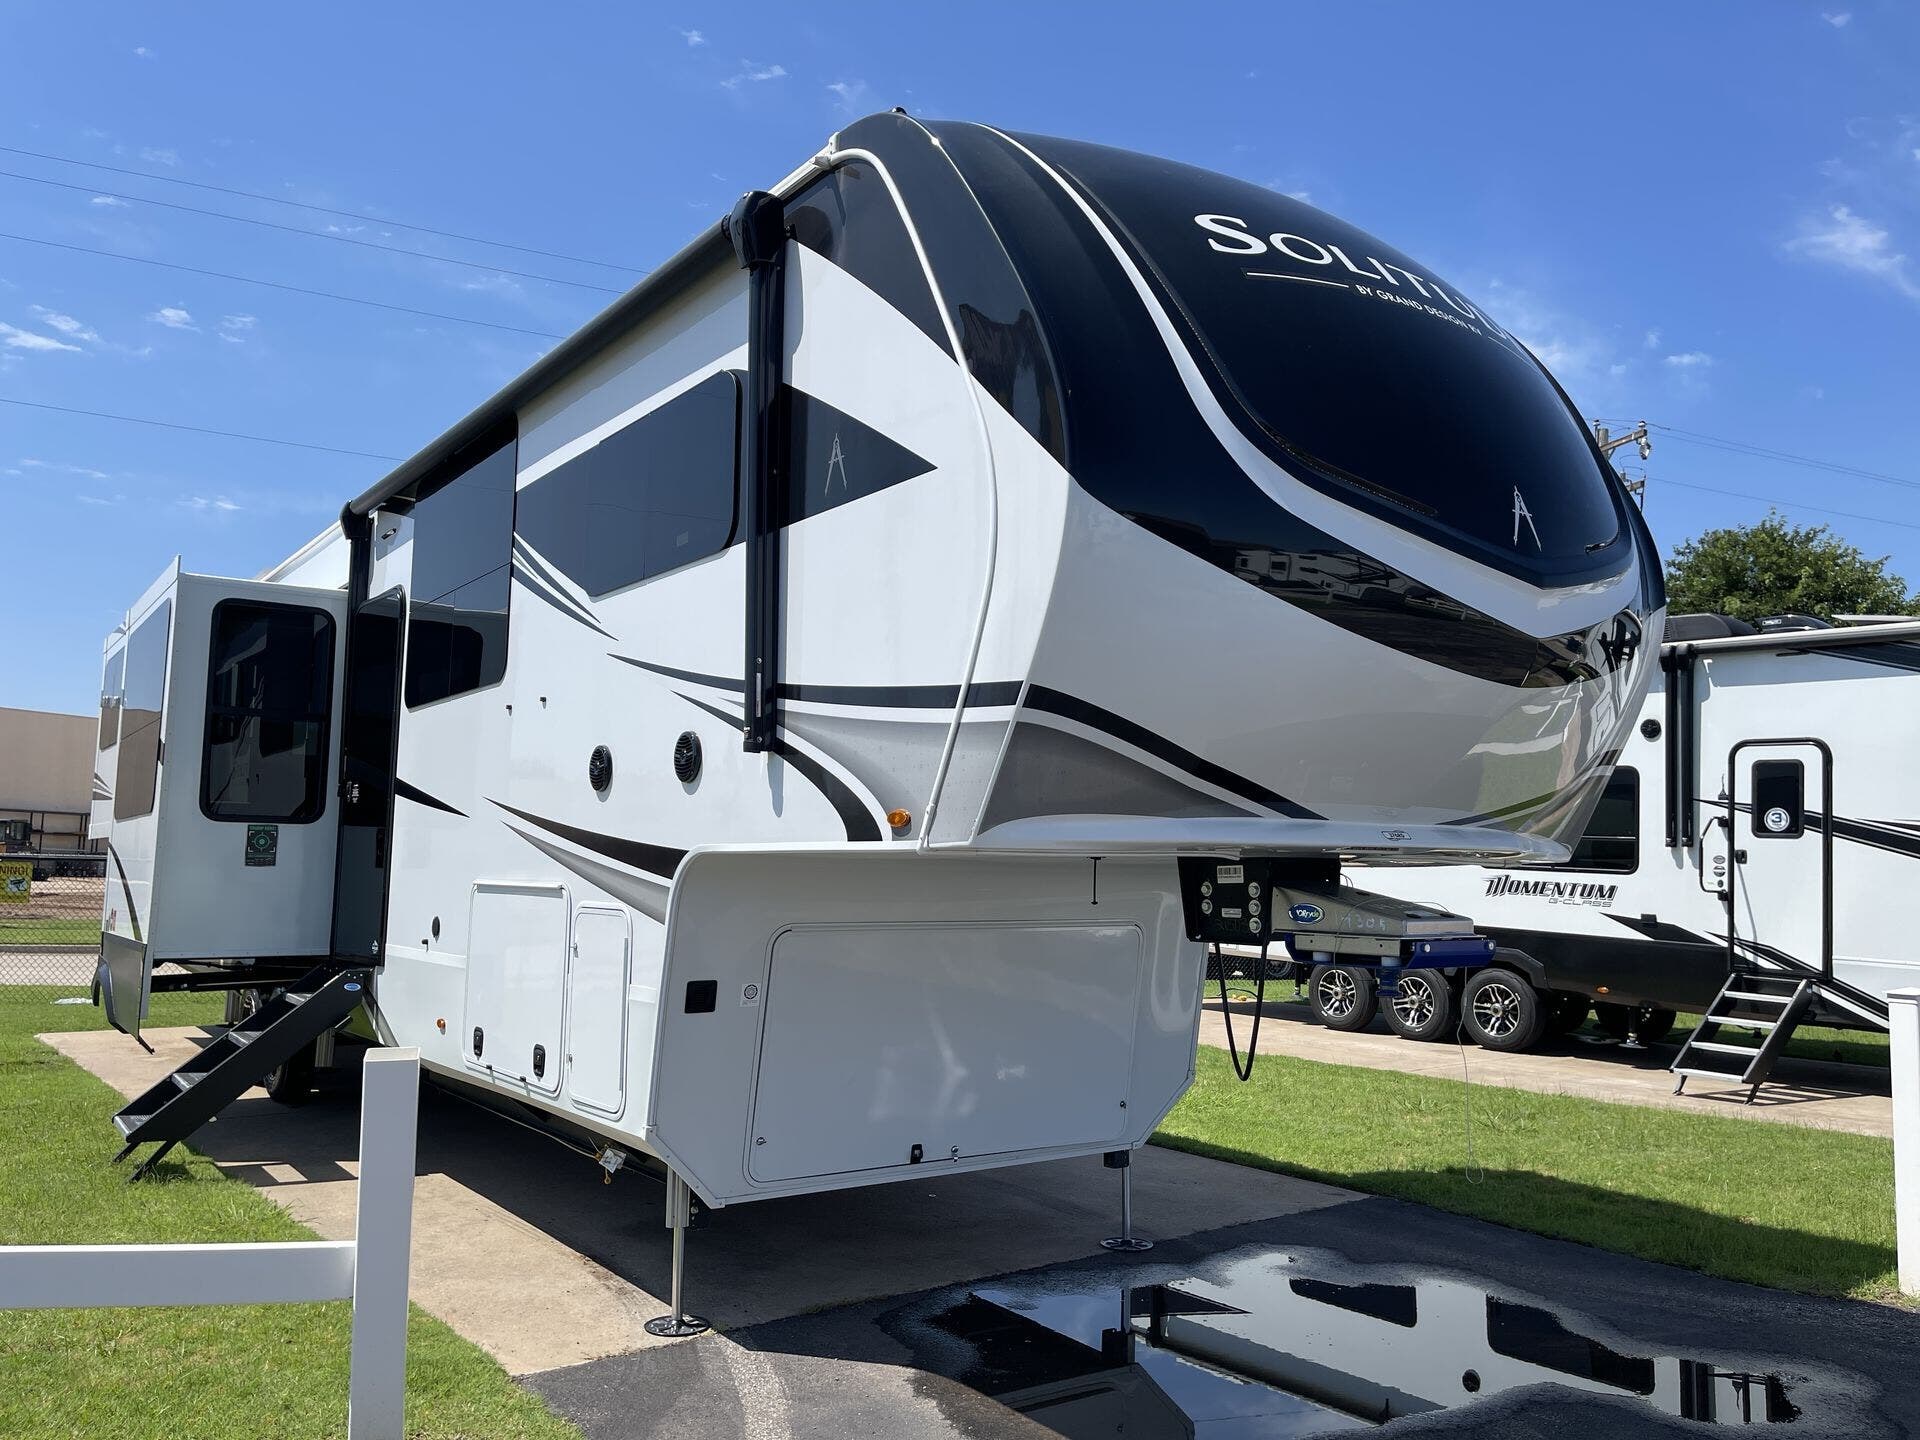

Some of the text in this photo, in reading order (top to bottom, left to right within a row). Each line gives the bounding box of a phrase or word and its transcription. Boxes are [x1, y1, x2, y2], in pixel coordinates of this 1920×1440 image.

[1355, 284, 1374, 297] BY
[1376, 288, 1424, 311] GRAND
[1771, 811, 1783, 824] 3
[1484, 874, 1618, 901] MOMENTUM
[1548, 897, 1613, 908] G-CLASS
